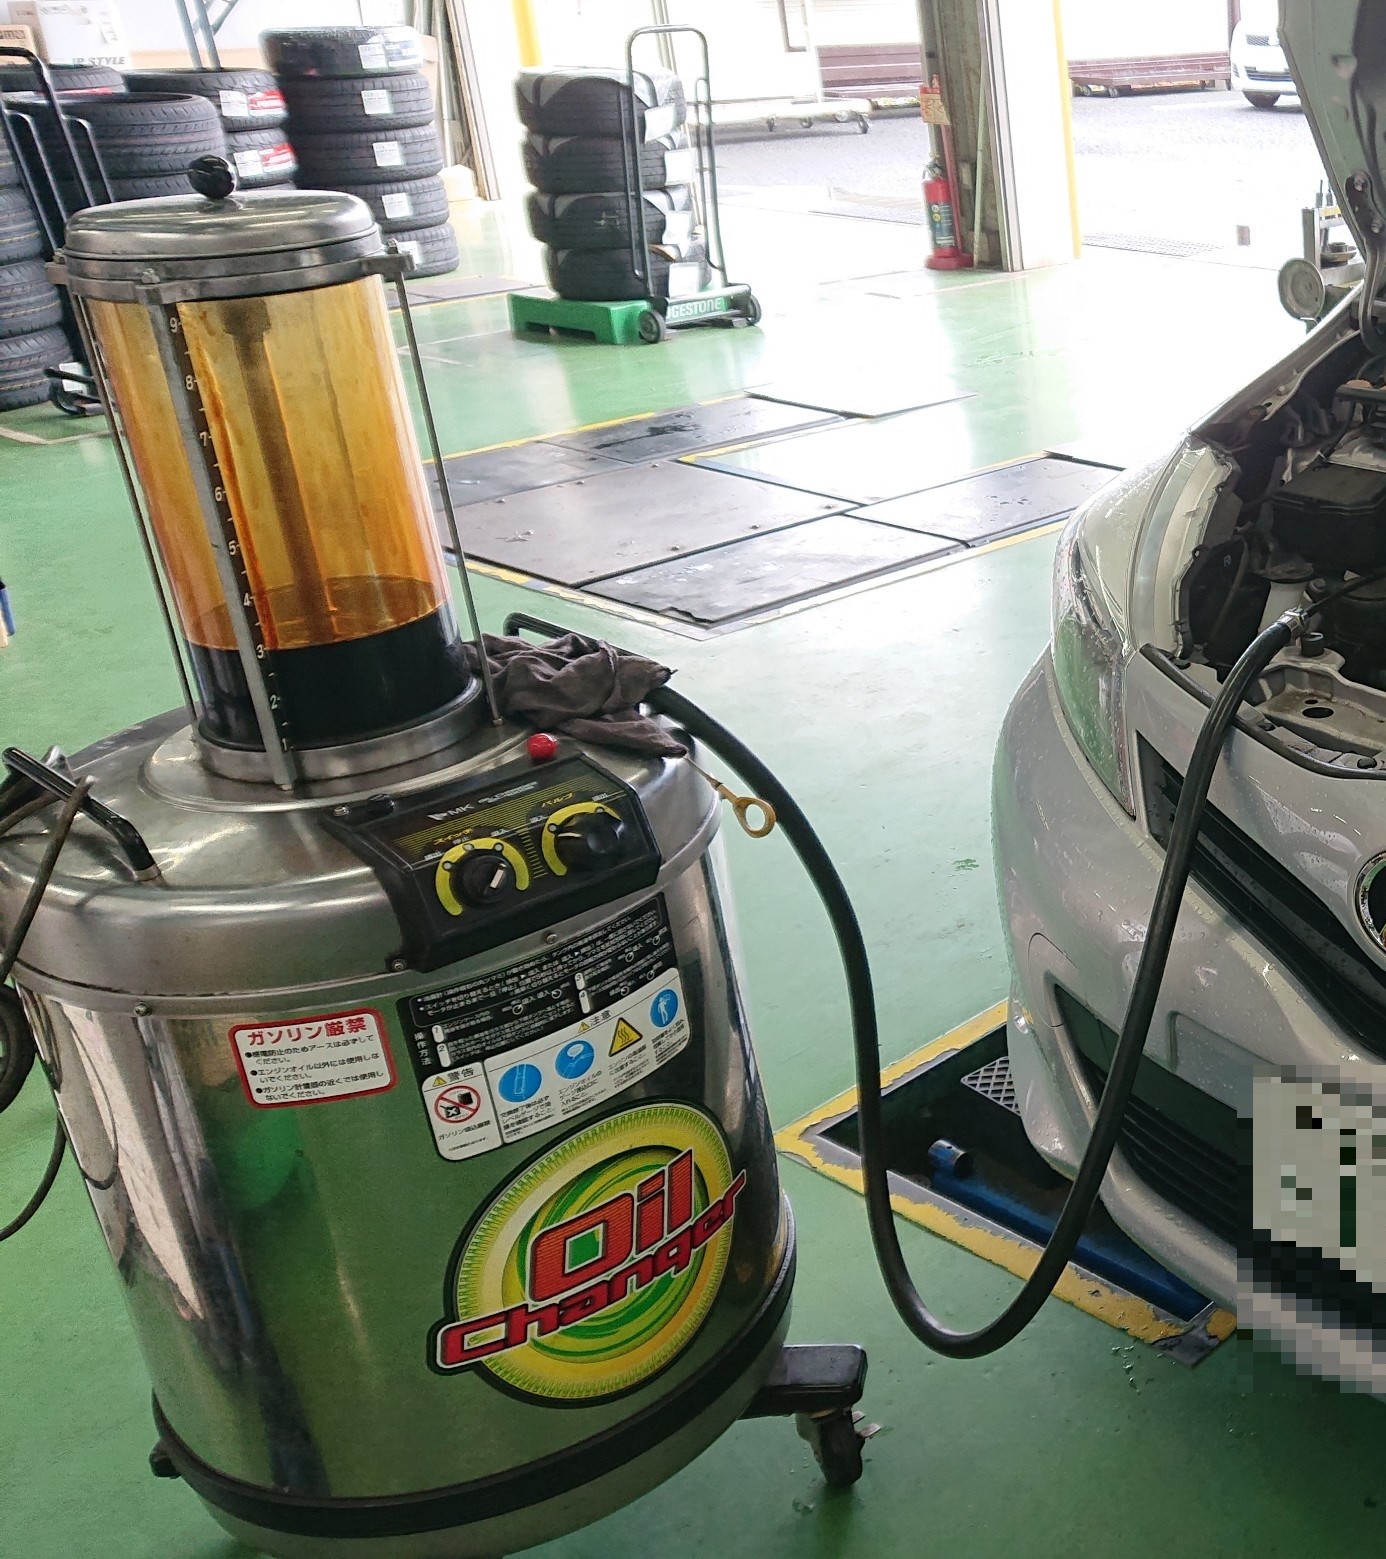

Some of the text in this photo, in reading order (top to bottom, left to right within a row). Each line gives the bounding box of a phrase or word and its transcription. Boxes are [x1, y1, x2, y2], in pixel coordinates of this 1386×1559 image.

[169, 317, 179, 333] 9
[185, 375, 194, 390] 8
[200, 432, 208, 446] 7
[214, 486, 223, 502] 6
[228, 541, 237, 556] 5
[243, 592, 251, 607] 4
[256, 644, 265, 659] 3
[270, 695, 278, 710] 2
[282, 738, 288, 751] 1
[433, 828, 474, 845] スイッチ
[247, 1016, 367, 1046] ガソリン厳禁
[447, 1068, 474, 1082] 警告
[529, 1149, 693, 1302] Oil
